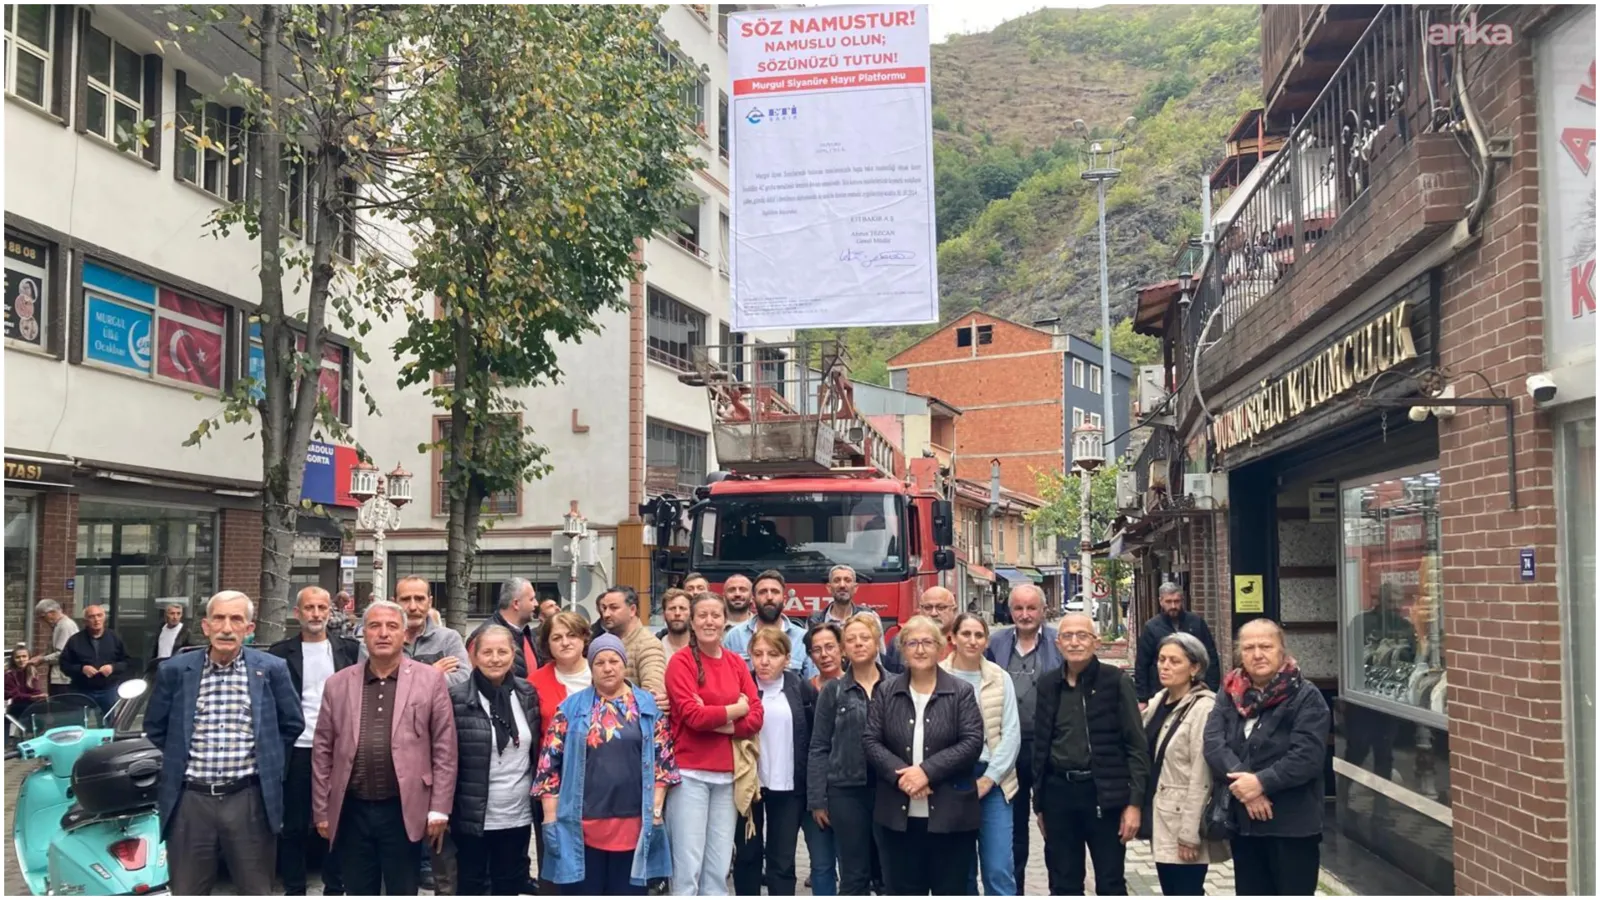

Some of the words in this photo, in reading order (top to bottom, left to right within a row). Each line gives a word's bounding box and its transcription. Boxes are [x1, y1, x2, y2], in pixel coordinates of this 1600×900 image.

[741, 18, 783, 38] SÖZ
[790, 10, 916, 34] NAMUSTUR!
[764, 36, 836, 53] NAMUSLU
[840, 34, 886, 47] OLUN;
[757, 54, 839, 73] SÖZÜNÜZÜ
[843, 52, 898, 67] TUTUN!
[752, 81, 785, 91] Murgul
[787, 77, 829, 89] Siyanüre
[831, 75, 855, 86] Hayır
[858, 71, 906, 82] Platformu
[8, 242, 21, 255] 88
[95, 312, 126, 330] MURGUL
[1287, 300, 1417, 417] KUYUMCULUK
[307, 444, 335, 456] ADOLU
[306, 454, 331, 466] GORTA
